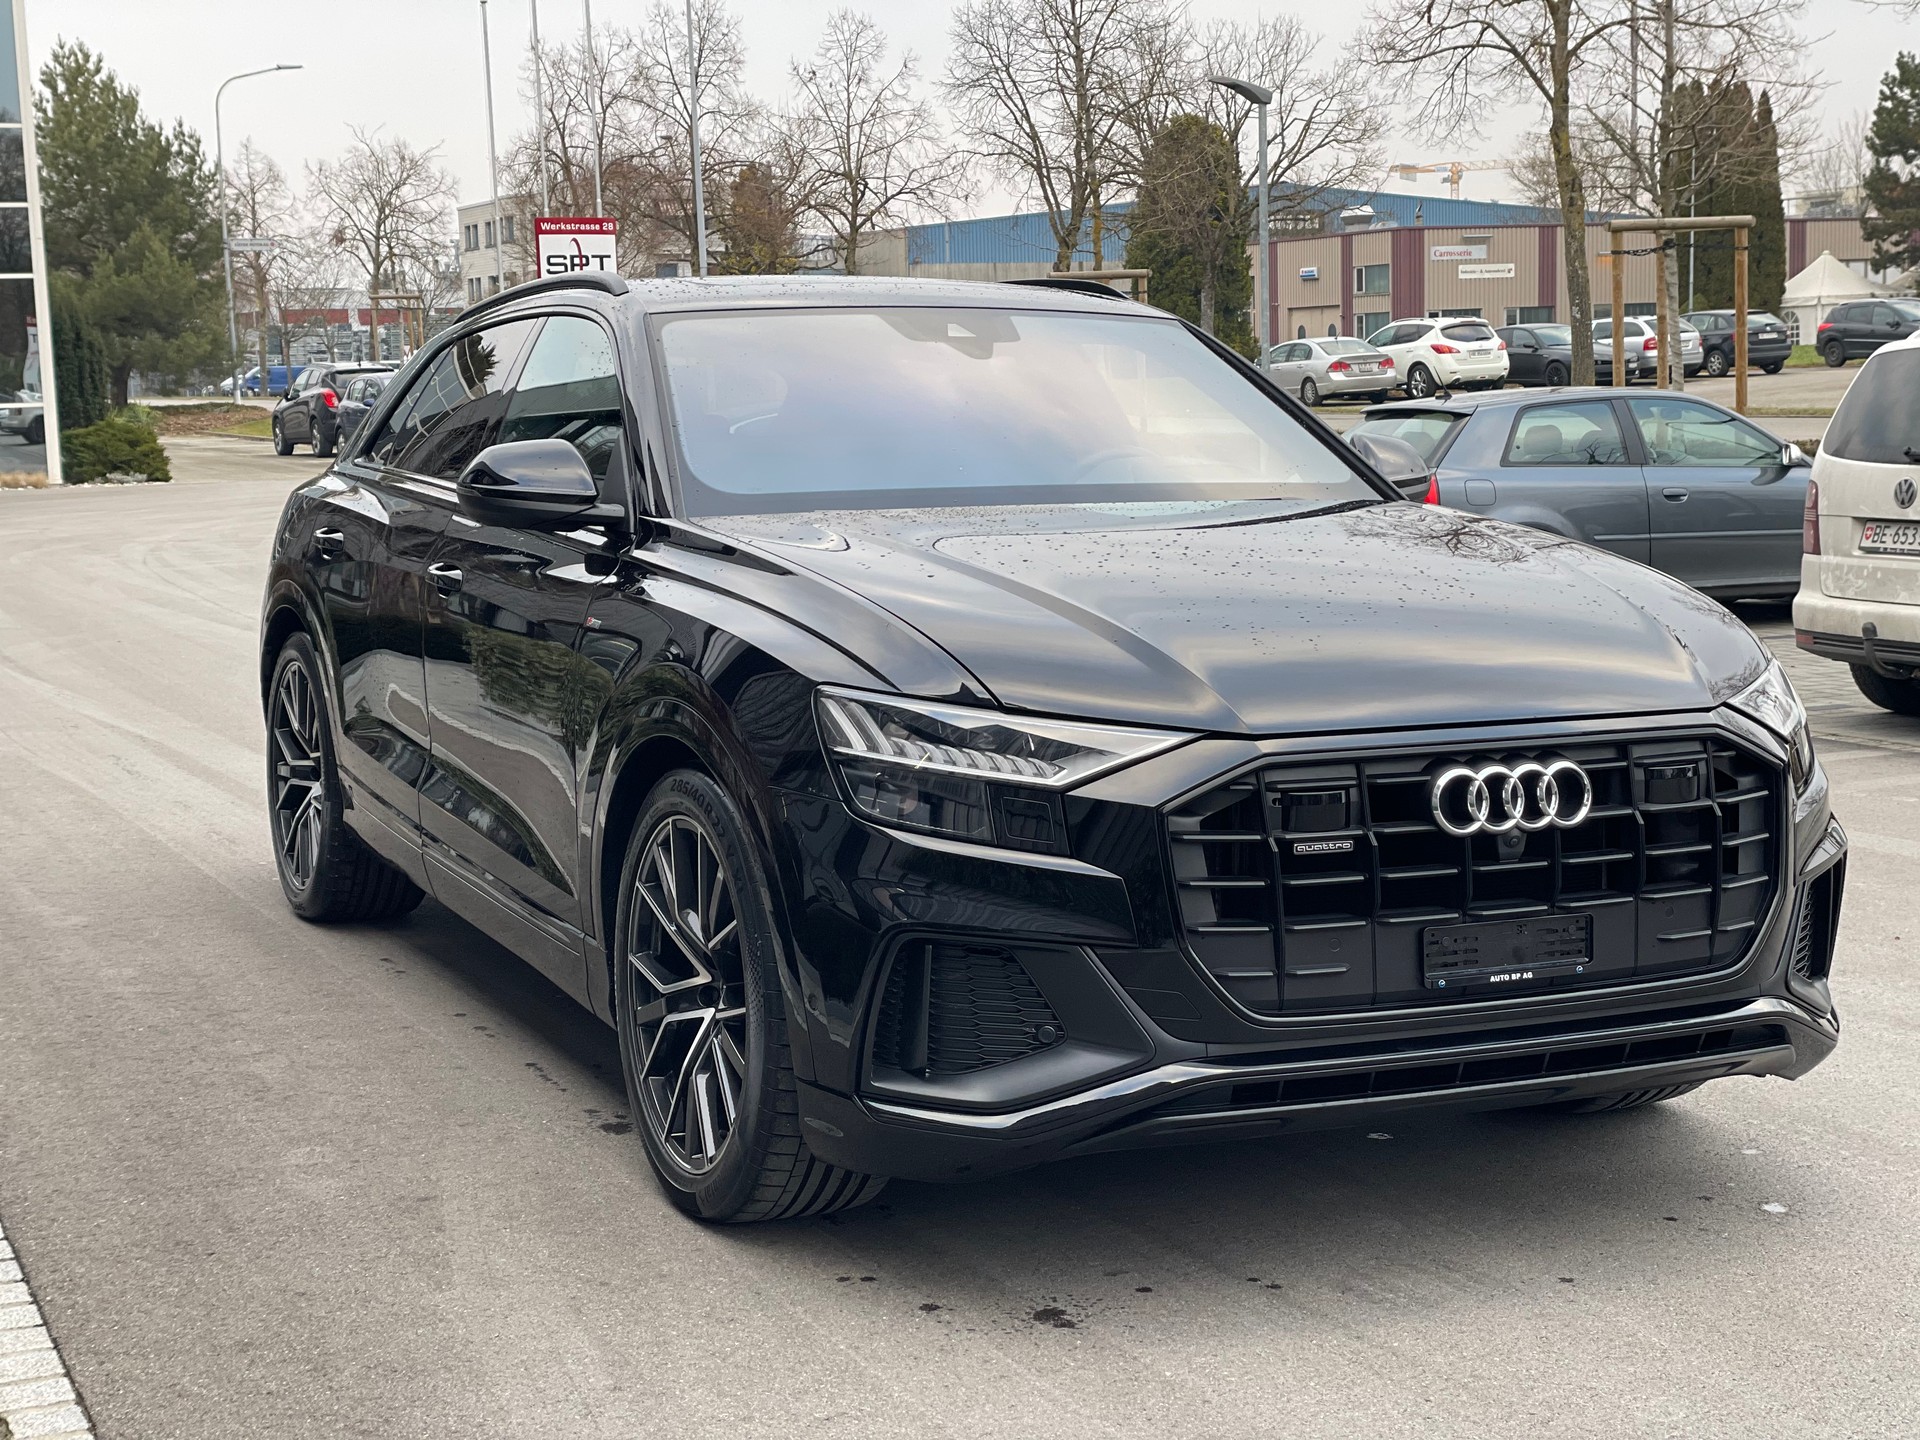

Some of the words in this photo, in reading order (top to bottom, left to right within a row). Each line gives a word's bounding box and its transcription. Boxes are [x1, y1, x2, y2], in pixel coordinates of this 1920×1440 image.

[540, 222, 600, 230] Werkstrasse
[602, 222, 614, 230] 28
[1433, 249, 1473, 257] Carrosserie
[546, 254, 611, 275] SPT
[1297, 843, 1351, 852] quattro
[1490, 974, 1510, 983] AUTO
[1511, 972, 1521, 981] BP
